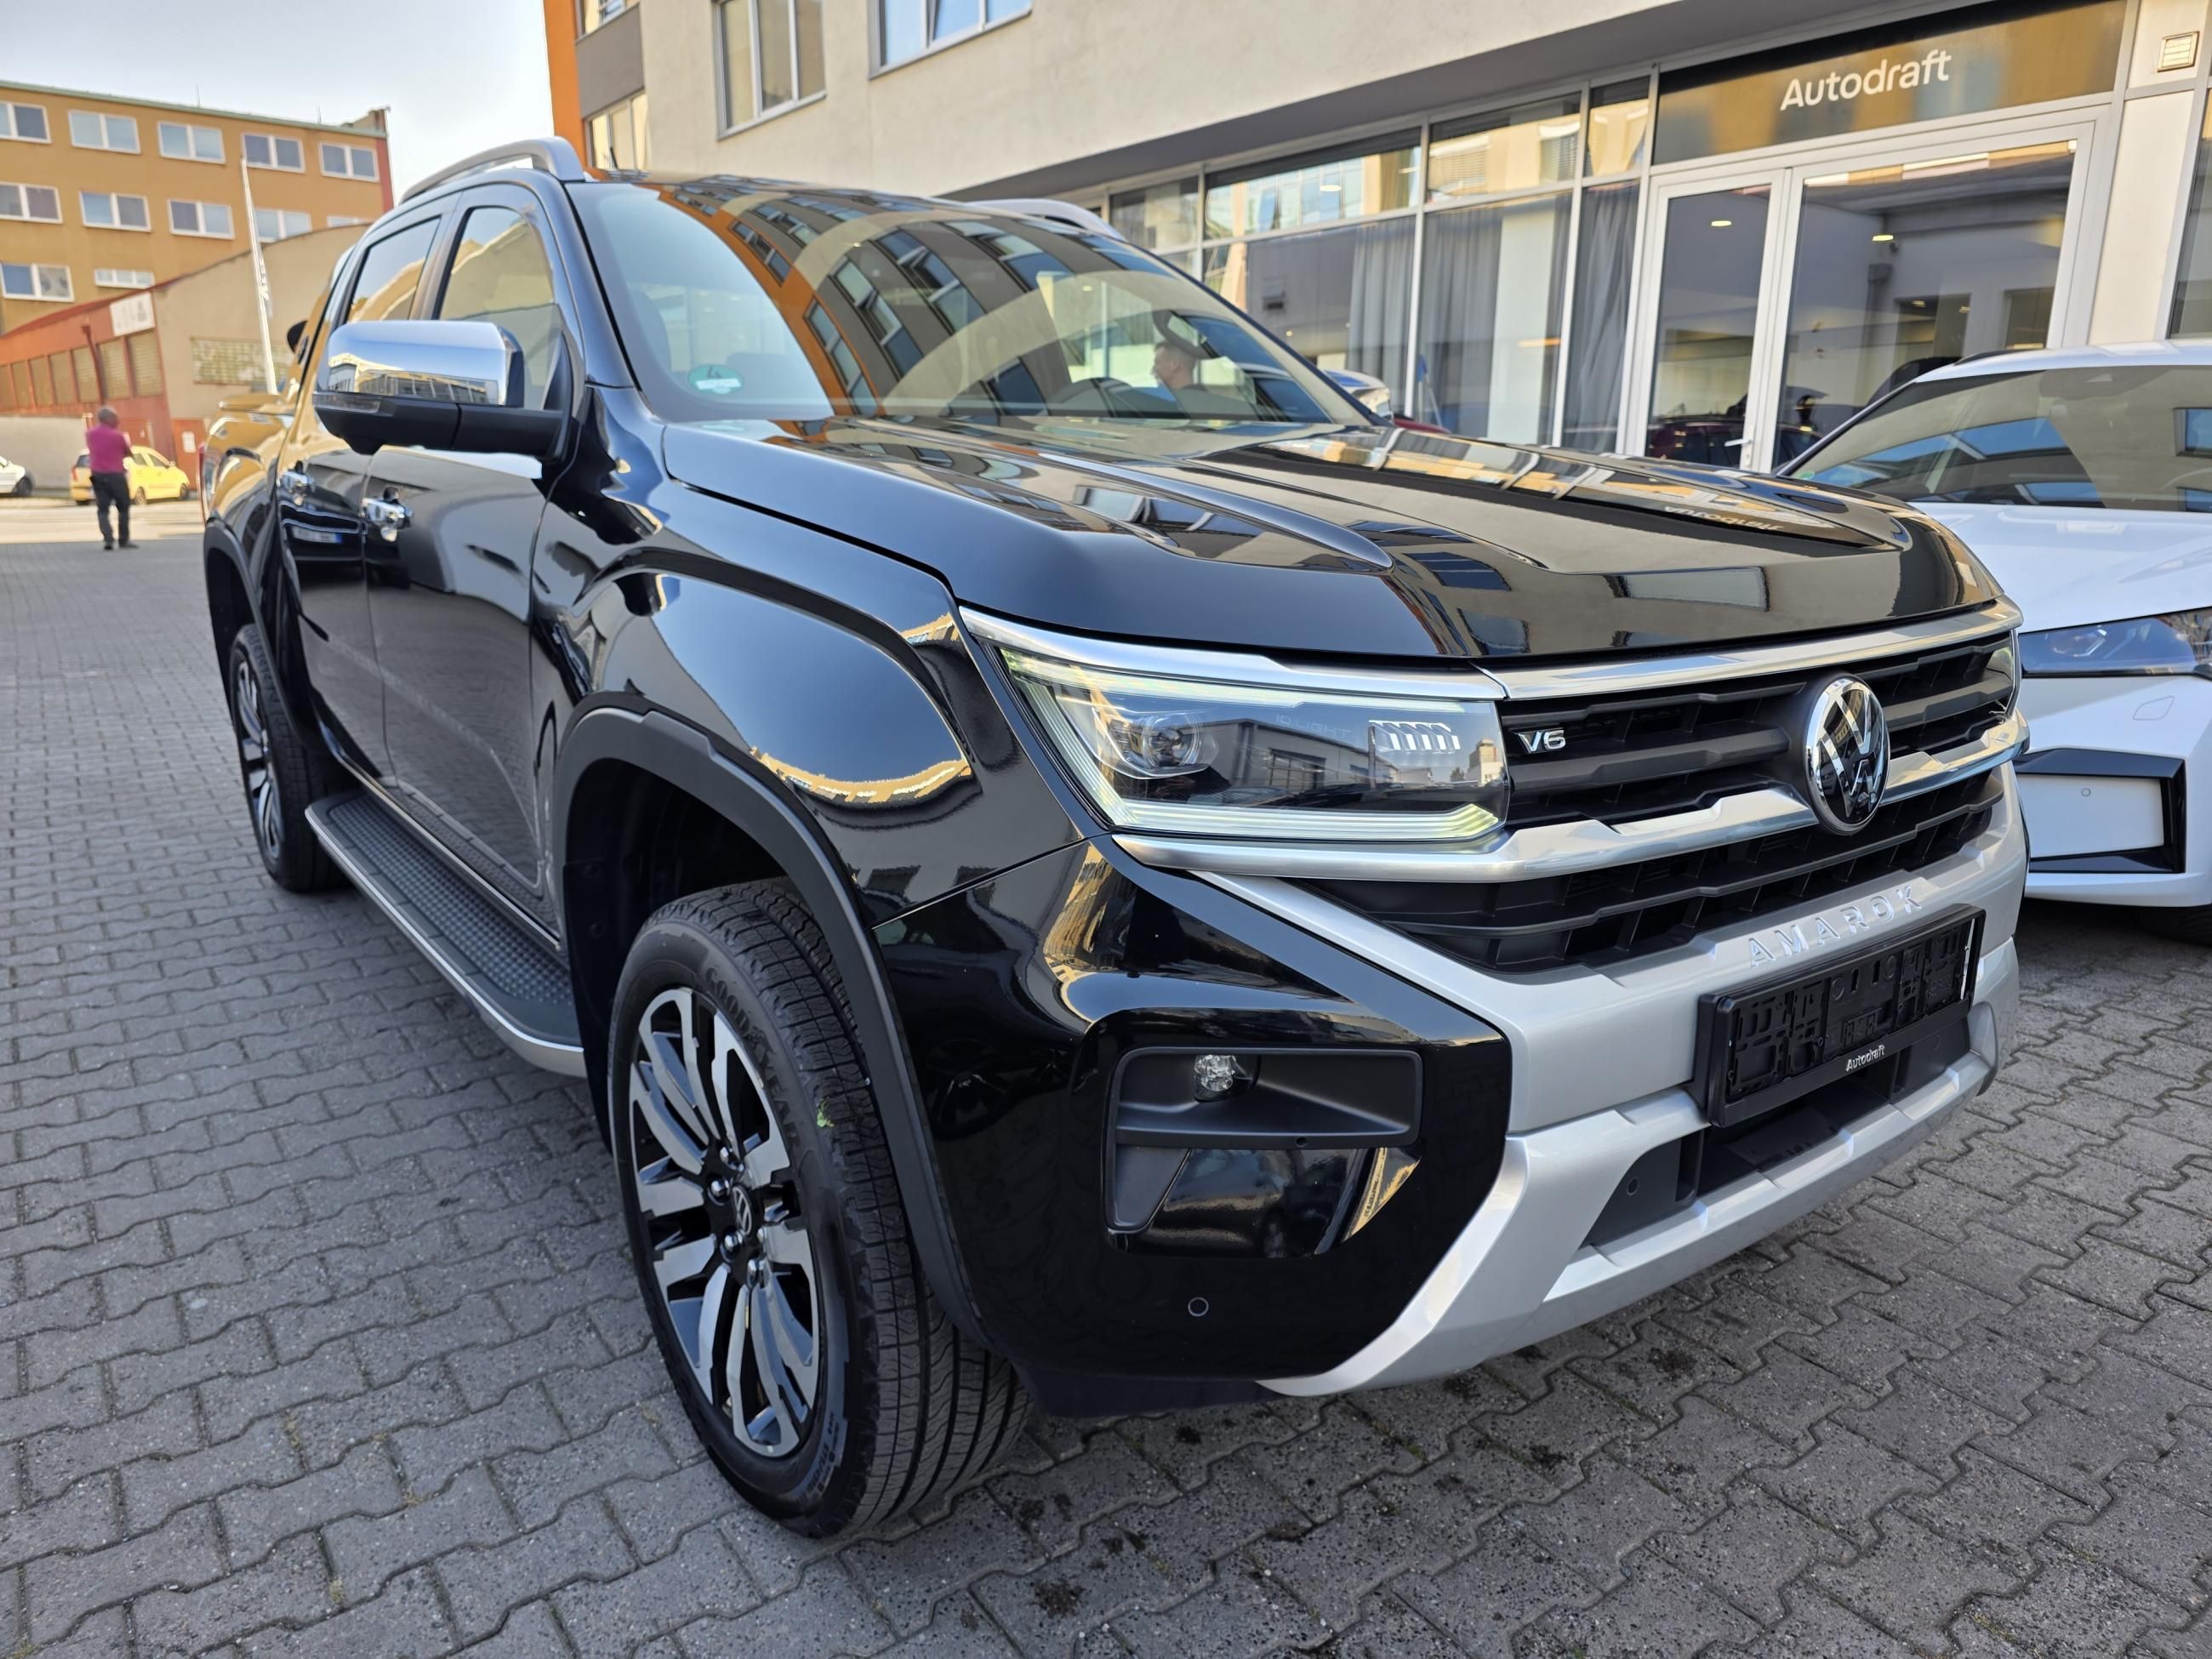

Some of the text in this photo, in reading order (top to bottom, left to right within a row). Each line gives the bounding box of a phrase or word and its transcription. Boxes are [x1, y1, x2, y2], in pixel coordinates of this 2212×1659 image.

[1779, 48, 1953, 111] Autodraft
[1517, 729, 1566, 754] V6
[1748, 885, 1923, 967] AMAROK
[705, 966, 801, 1149] GOODYEAR
[1845, 1044, 1886, 1072] Autodraft
